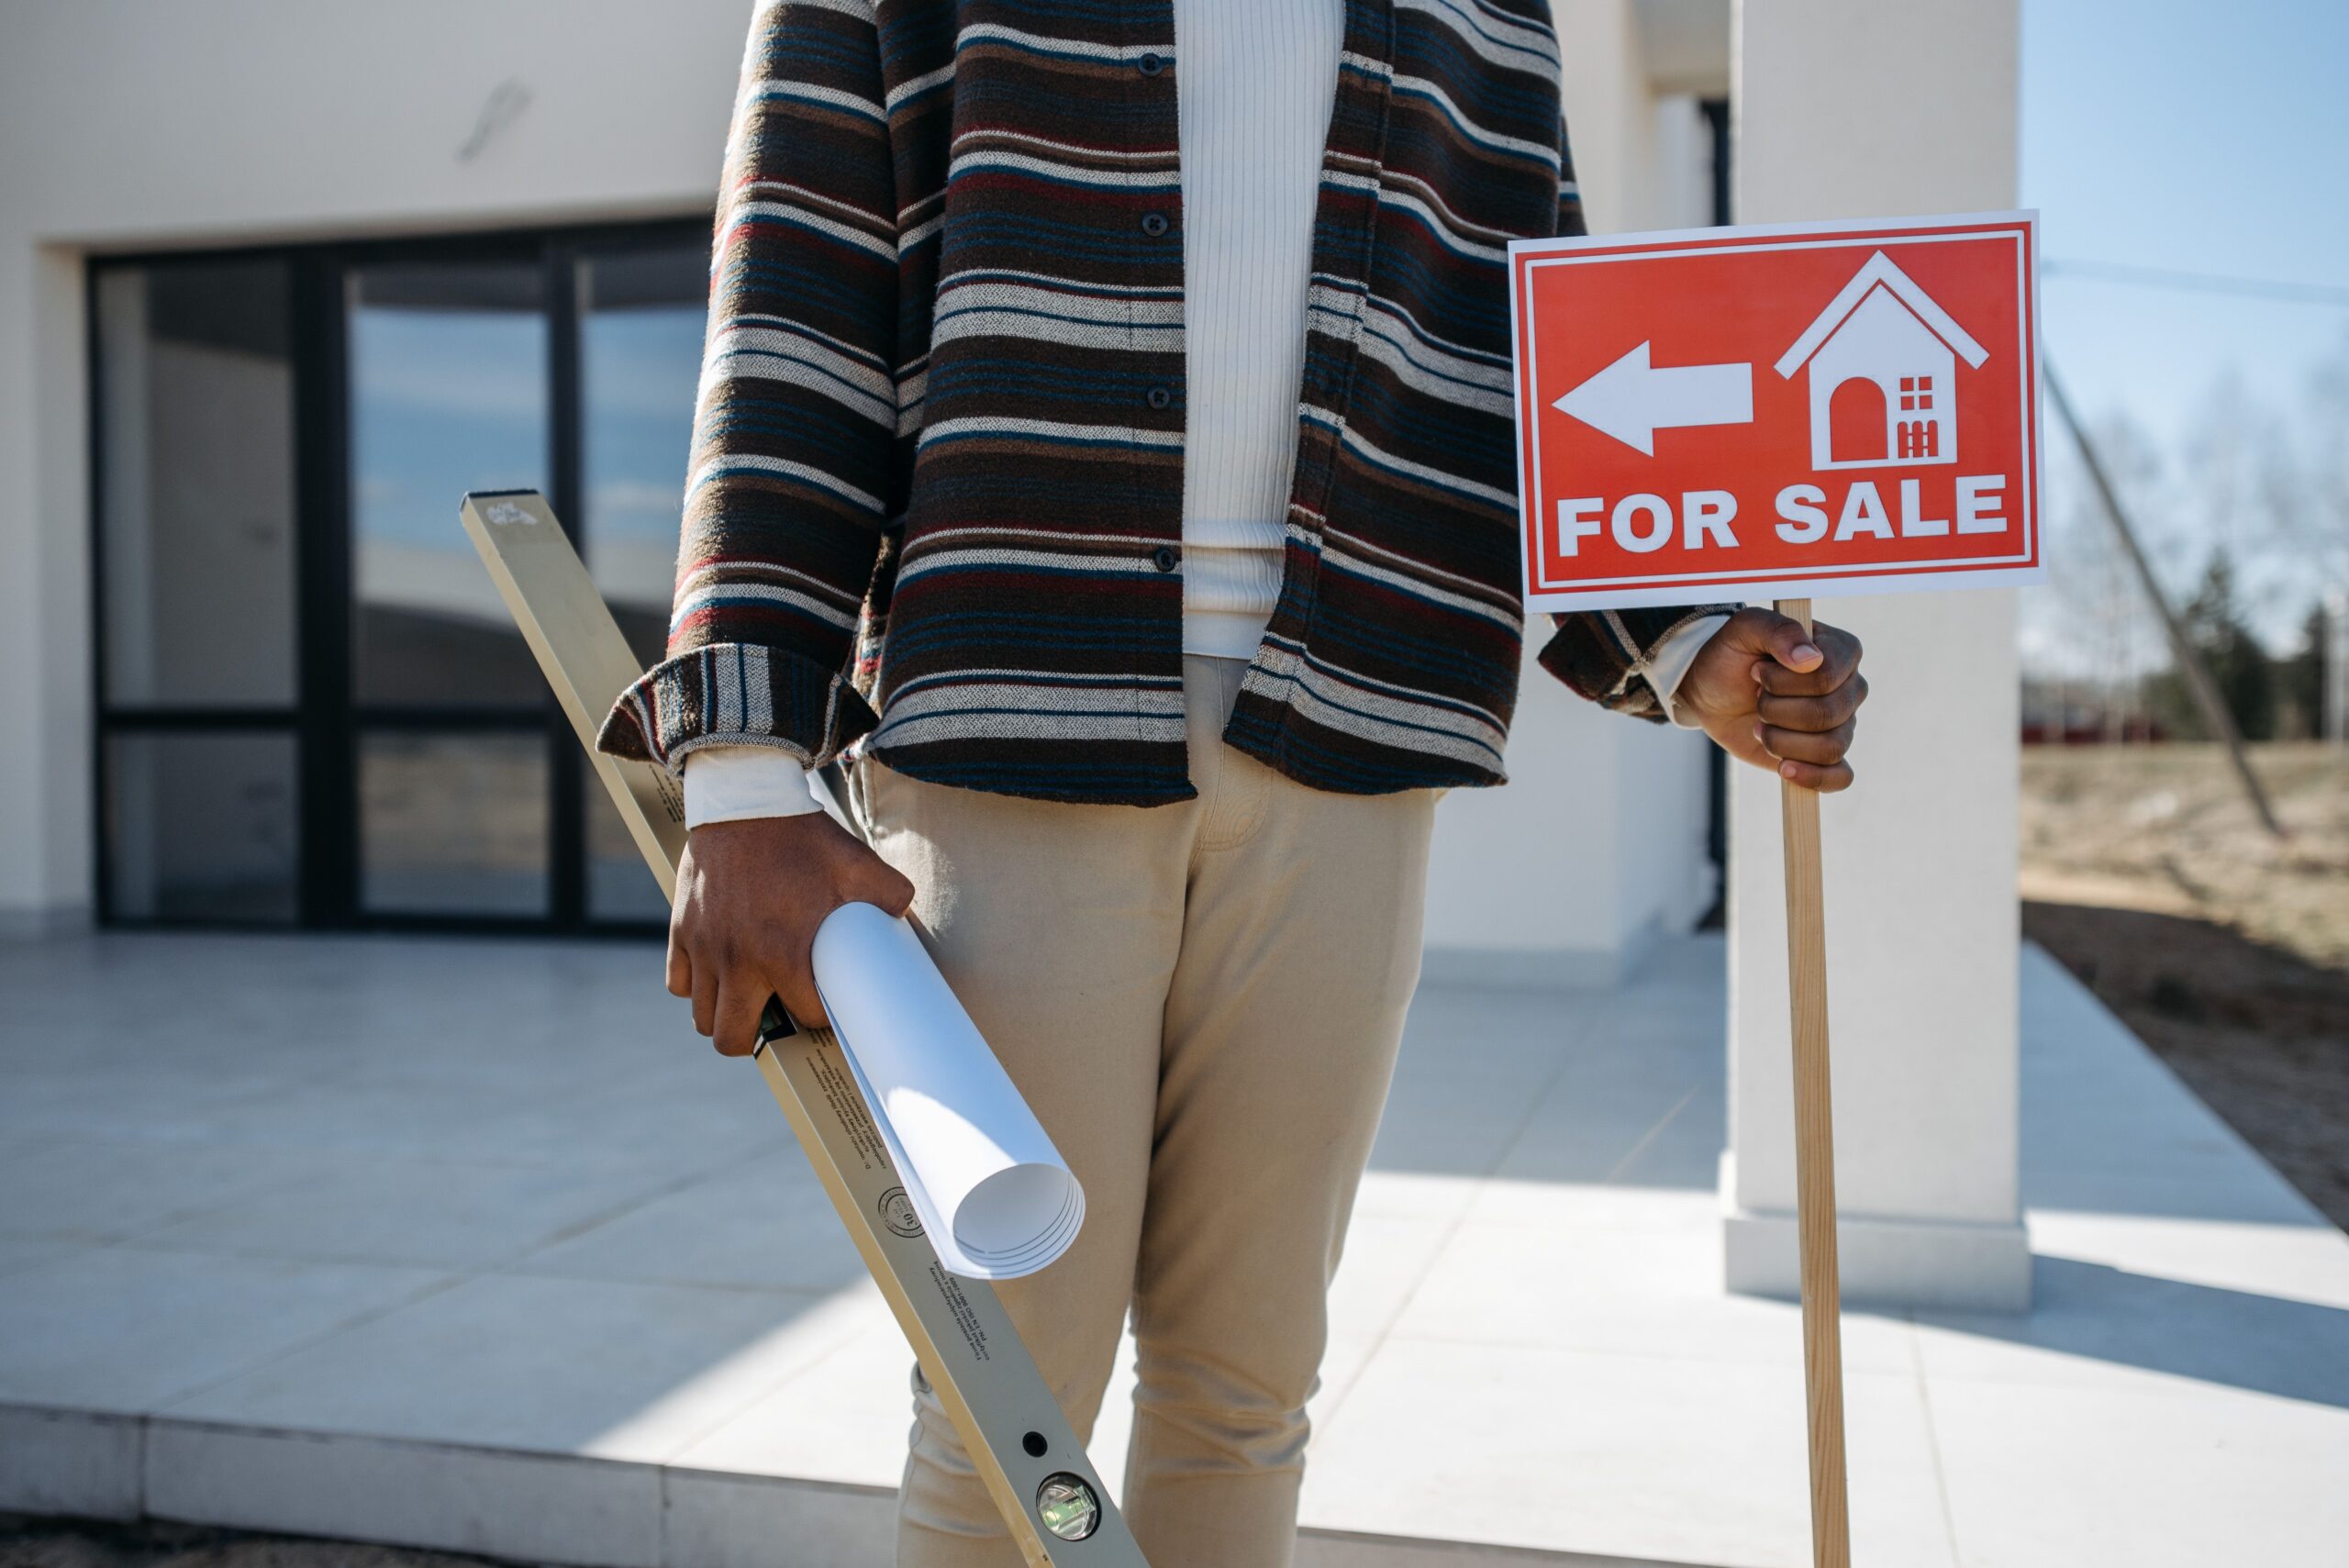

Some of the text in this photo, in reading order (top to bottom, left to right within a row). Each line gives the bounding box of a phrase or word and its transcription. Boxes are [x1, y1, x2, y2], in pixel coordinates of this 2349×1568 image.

[1557, 473, 2009, 557] FOR SALE
[835, 1110, 852, 1136] obudowy
[904, 1213, 918, 1228] 30
[965, 1307, 975, 1319] ISO
[956, 1317, 973, 1342] posiada
[969, 1341, 982, 1361] Firma
